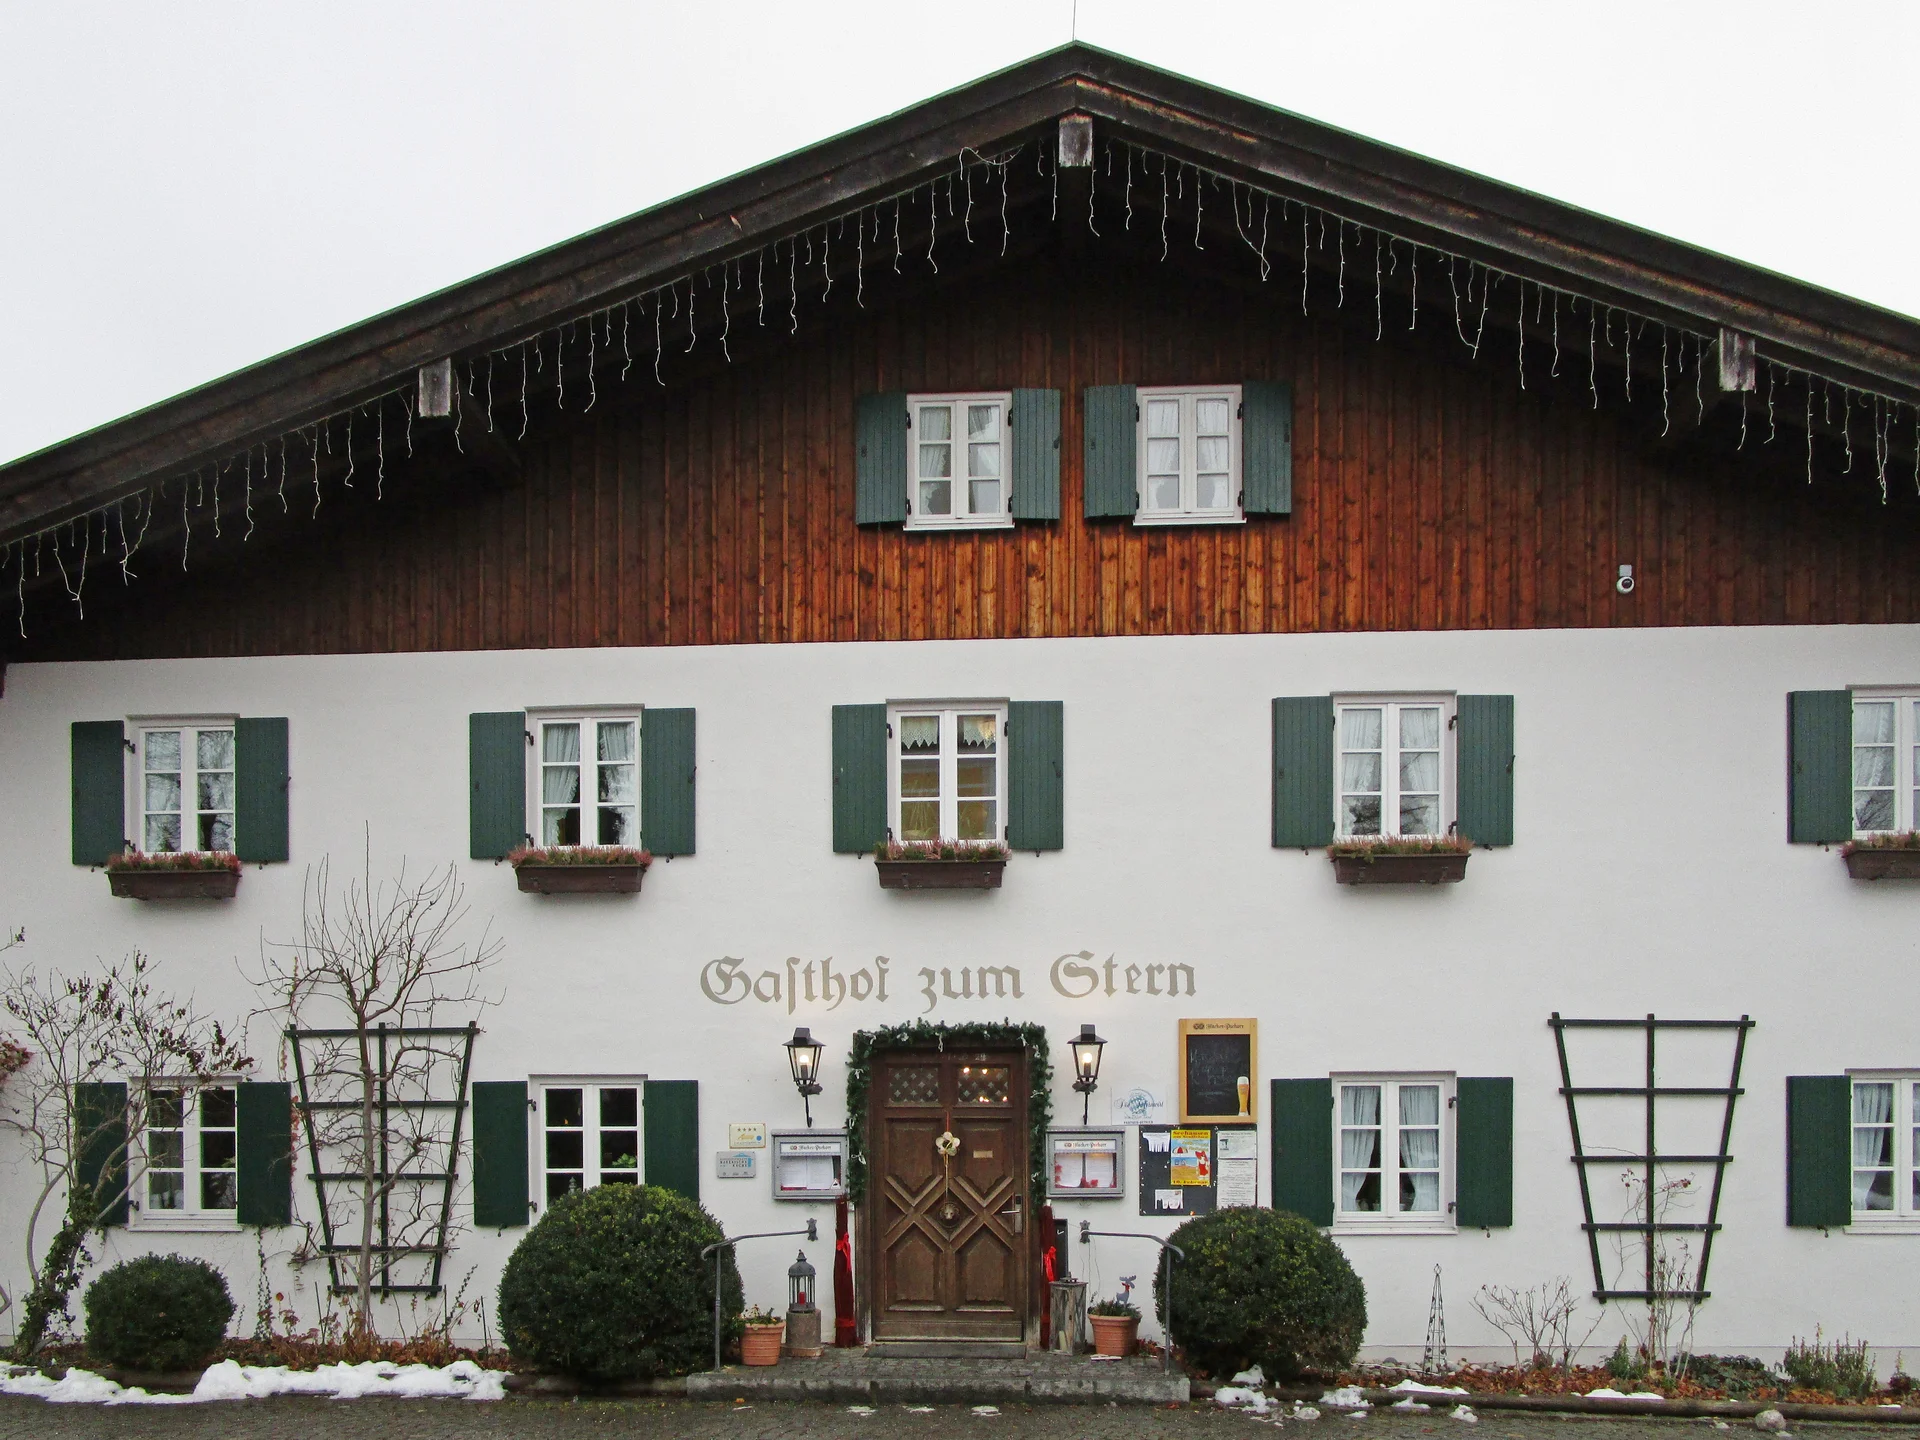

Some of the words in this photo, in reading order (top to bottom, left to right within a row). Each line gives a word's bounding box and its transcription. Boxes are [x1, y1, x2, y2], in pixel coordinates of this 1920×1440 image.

[700, 955, 890, 1015] Gasthof
[918, 965, 1025, 1014] zum
[1050, 950, 1197, 998] Stern
